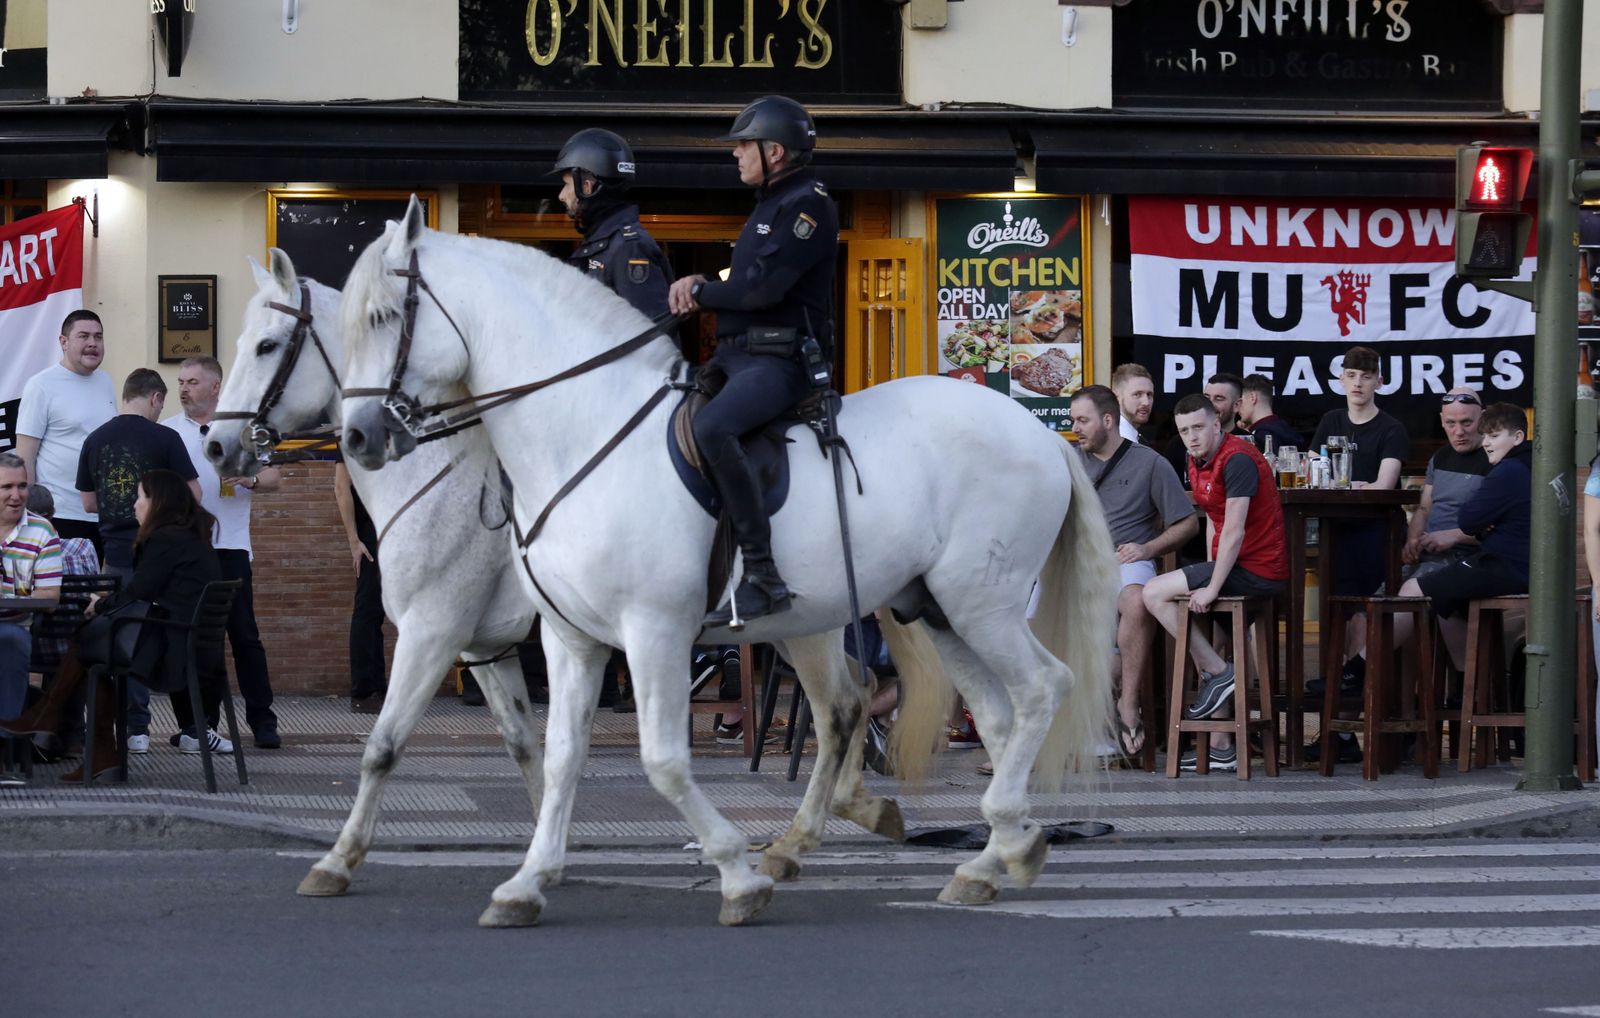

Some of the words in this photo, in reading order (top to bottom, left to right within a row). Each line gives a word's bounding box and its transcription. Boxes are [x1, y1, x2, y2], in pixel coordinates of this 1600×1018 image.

[525, 0, 833, 69] O'NEILL'S
[1185, 204, 1456, 248] UNKNOW
[939, 257, 1079, 287] KITCHEN
[938, 288, 985, 304] OPEN
[938, 304, 969, 320] ALL
[972, 304, 1009, 320] DAY
